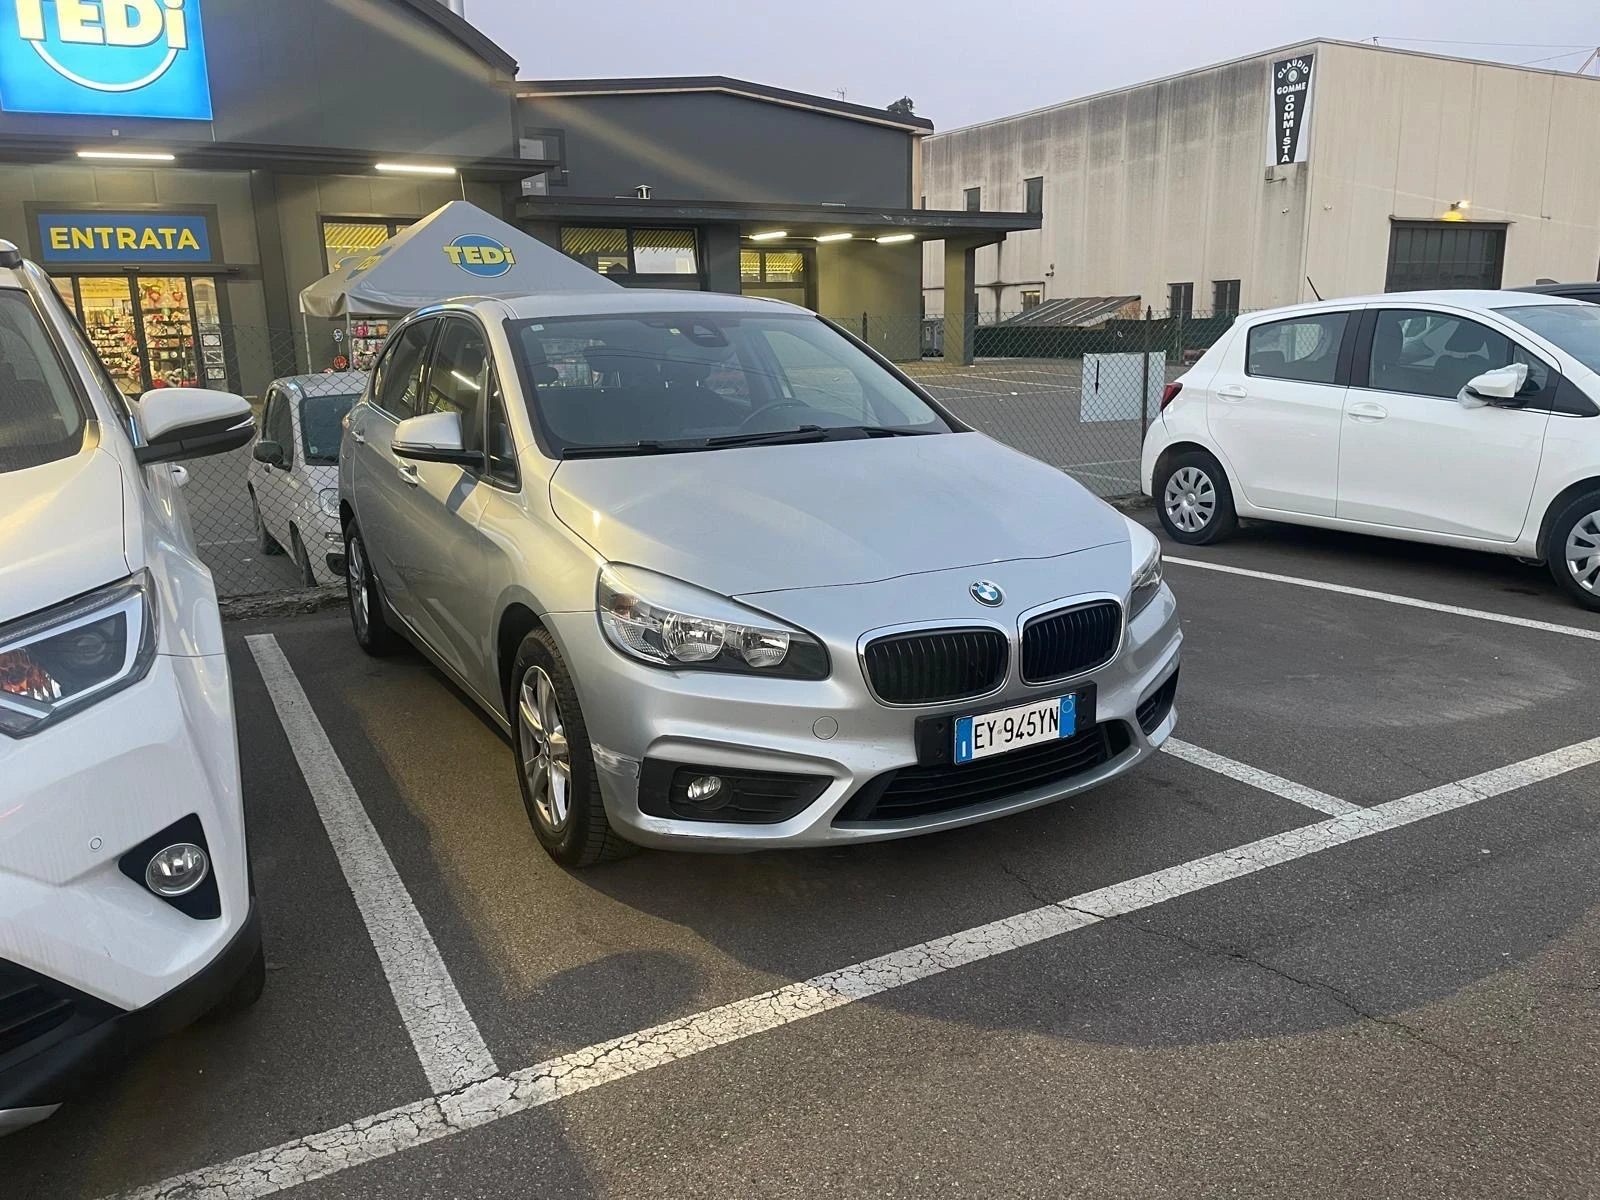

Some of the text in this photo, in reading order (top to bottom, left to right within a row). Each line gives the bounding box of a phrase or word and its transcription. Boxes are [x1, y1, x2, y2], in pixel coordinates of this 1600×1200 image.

[1277, 59, 1309, 79] CLAUDIO
[1276, 82, 1307, 95] GOMME
[1281, 94, 1295, 163] GOMMISTA
[50, 227, 200, 250] ENTRATA
[442, 246, 516, 265] TEDi
[974, 720, 997, 750] EY
[1004, 706, 1059, 743] 945YN
